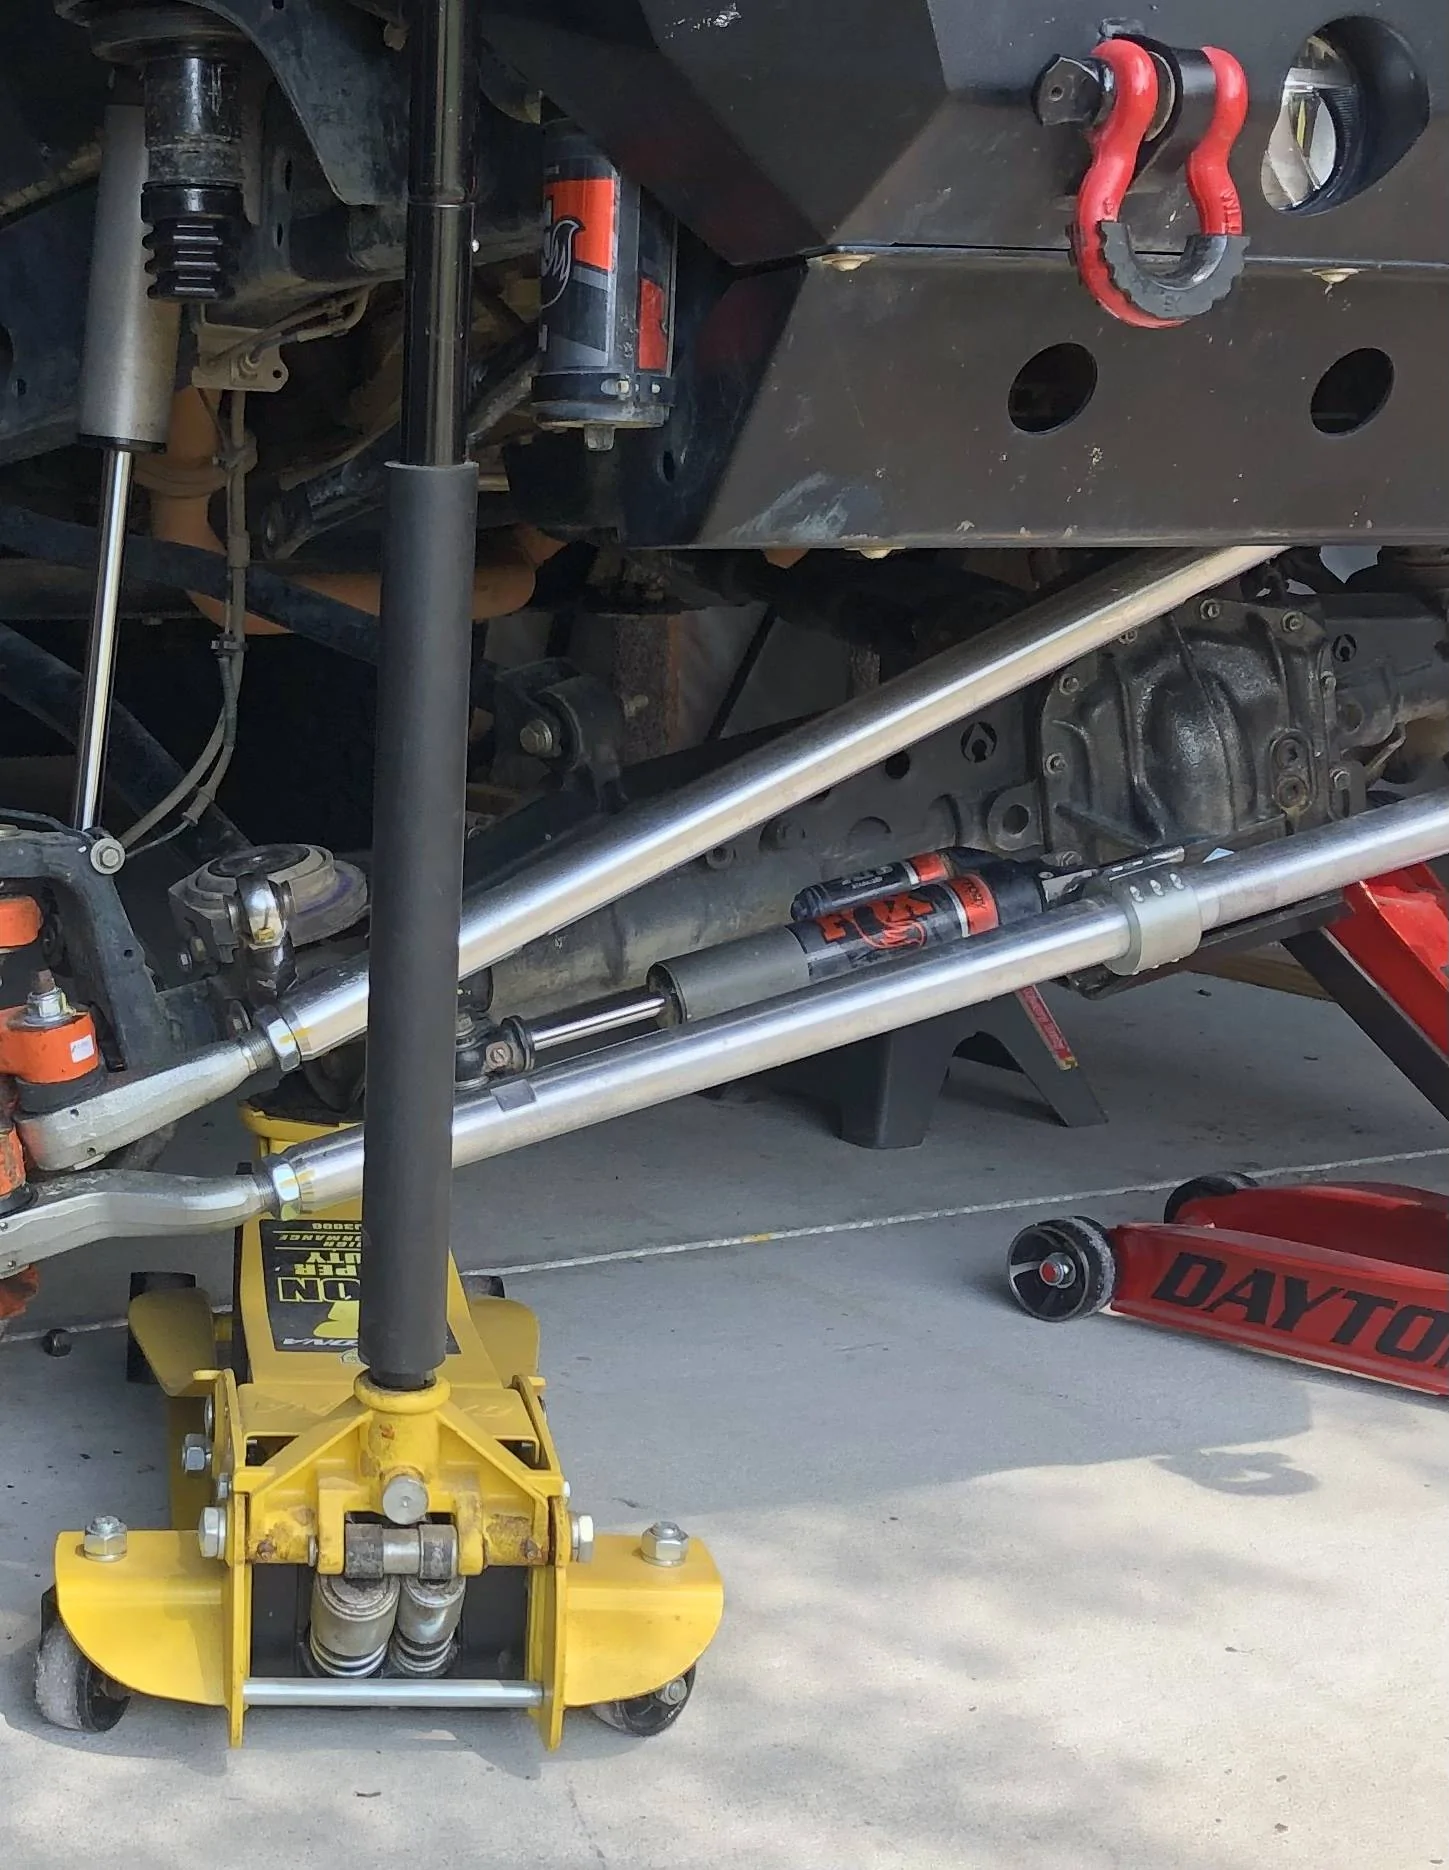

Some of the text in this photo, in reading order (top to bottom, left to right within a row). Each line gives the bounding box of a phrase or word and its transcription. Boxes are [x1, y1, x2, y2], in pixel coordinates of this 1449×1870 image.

[305, 1252, 362, 1264] UTY
[293, 1264, 358, 1276] PER
[277, 1277, 361, 1303] ON
[1153, 1252, 1449, 1368] DAYTO
